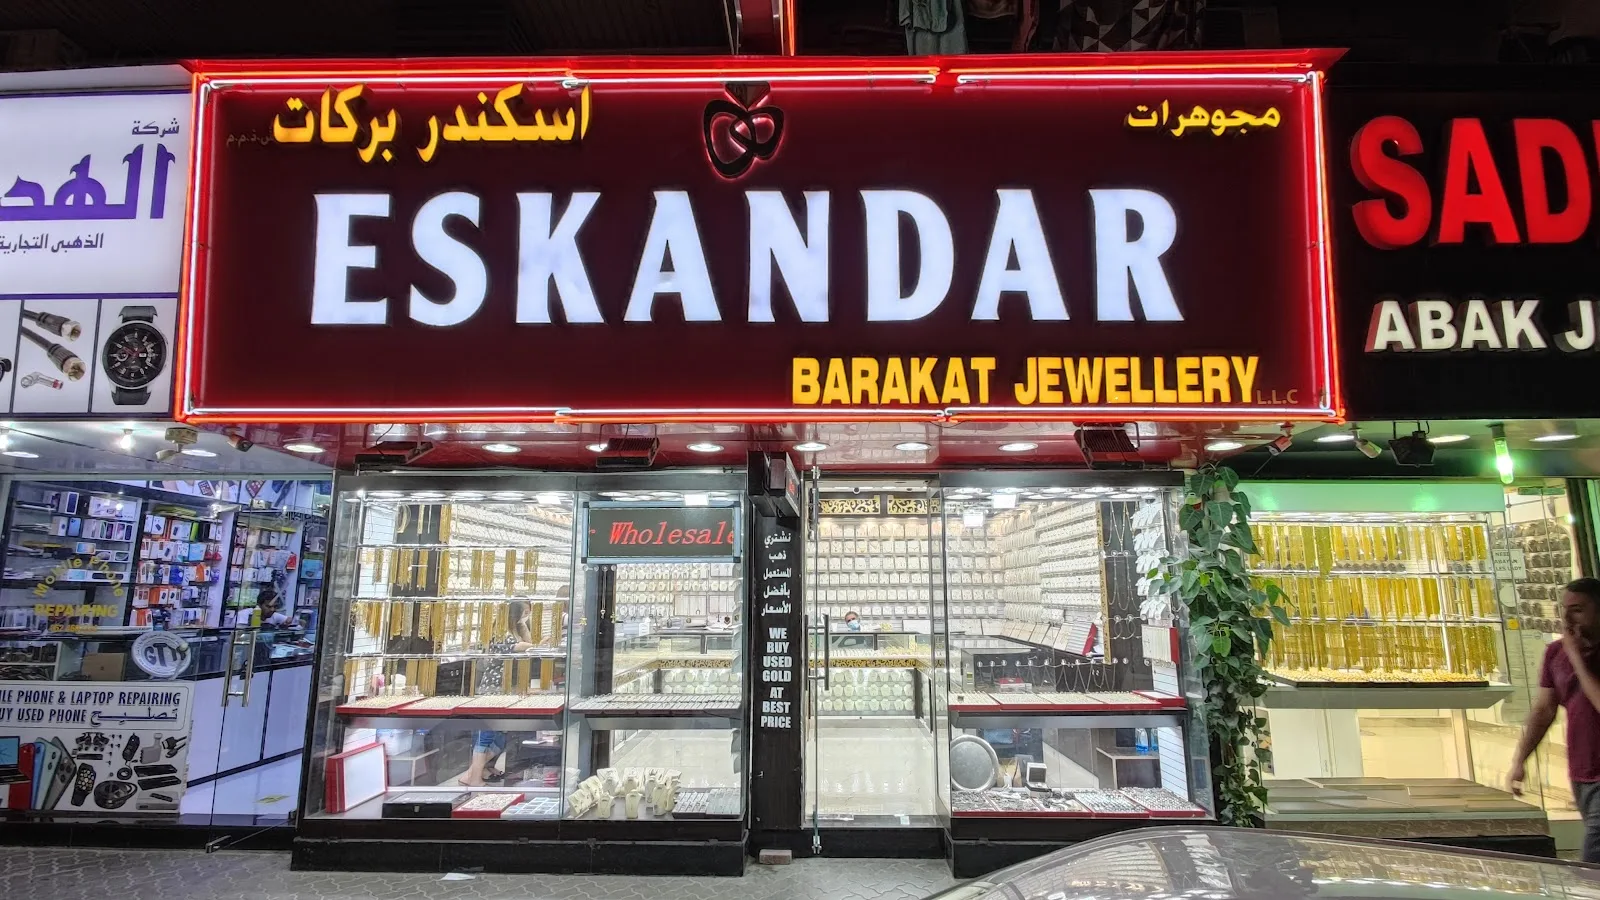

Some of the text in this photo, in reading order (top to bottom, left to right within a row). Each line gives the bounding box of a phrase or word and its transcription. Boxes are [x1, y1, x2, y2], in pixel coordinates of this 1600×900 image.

[273, 84, 399, 163] بركات
[415, 83, 592, 163] اسكندر
[1125, 99, 1281, 137] مجوهرات
[131, 118, 180, 137] شركة
[1351, 115, 1600, 249] SAD
[310, 188, 1185, 326] ESKANDAR
[1366, 298, 1547, 352] ABAK
[792, 355, 1299, 405] BARAKAT JEWELLERY L.L.C
[764, 530, 792, 548] نشتري
[768, 550, 787, 563] ذهب
[89, 555, 124, 597] Phone
[763, 567, 792, 580] المستعمل
[763, 582, 791, 598] بأفضل
[34, 603, 119, 617] REPAIRING
[761, 600, 792, 616] الأسعار
[768, 627, 788, 639] WE
[766, 641, 790, 653] BUY
[763, 655, 793, 668] USED
[762, 670, 792, 682] GOLD
[16, 690, 54, 704] PHONE
[58, 690, 66, 704] &
[70, 691, 114, 705] LAPTOP
[118, 692, 181, 706] REPAIRING
[769, 687, 784, 699] AT
[762, 701, 791, 714] BEST
[17, 708, 45, 722] USED
[49, 709, 87, 724] PHONE
[760, 715, 792, 728] PRICE
